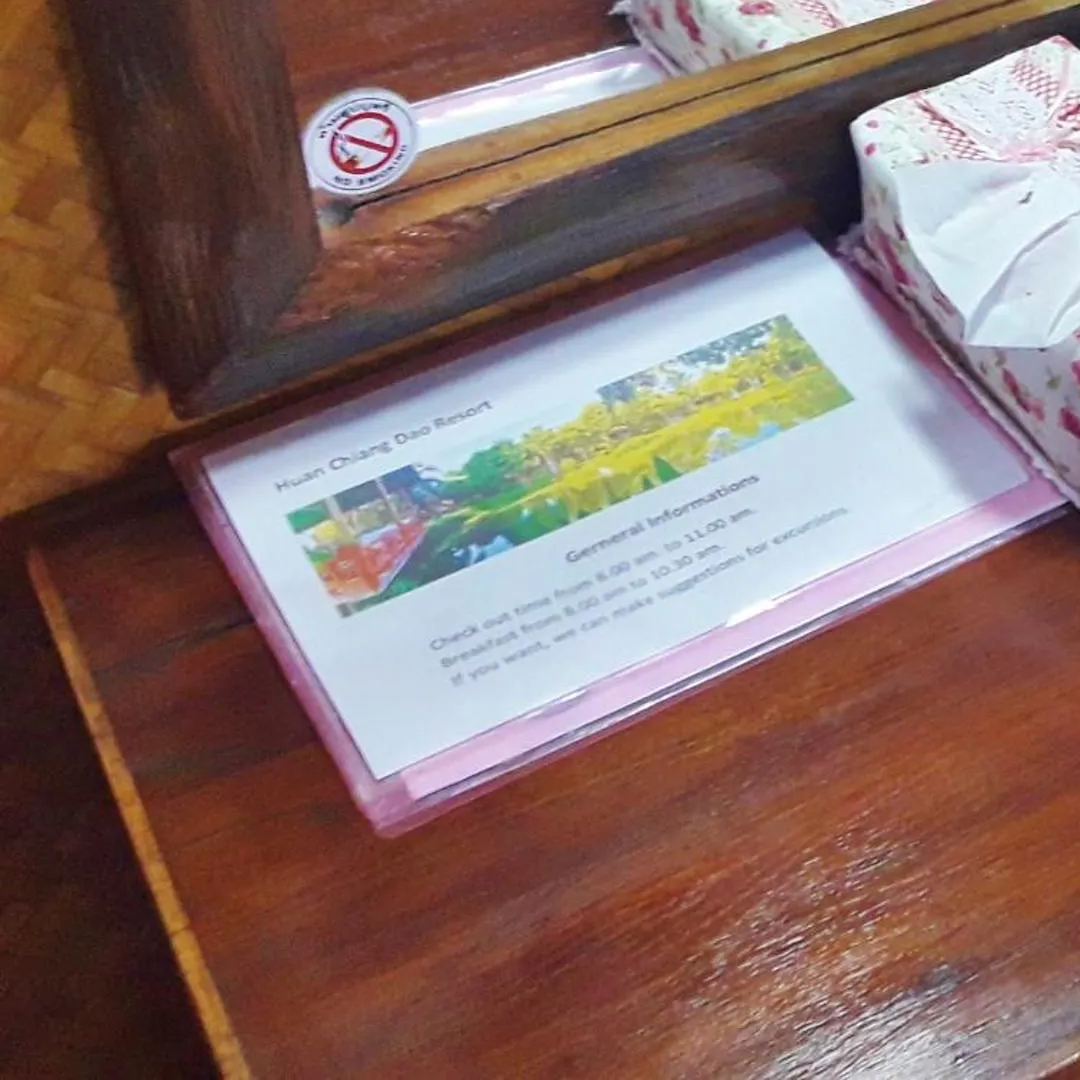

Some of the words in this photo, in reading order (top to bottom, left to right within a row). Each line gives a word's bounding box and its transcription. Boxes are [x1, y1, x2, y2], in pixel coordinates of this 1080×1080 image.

[328, 440, 393, 471] Chiang
[393, 424, 433, 445] Dao
[433, 400, 493, 430] Resort
[646, 474, 760, 528] Informations
[429, 625, 478, 650] Check
[513, 596, 551, 615] time
[663, 540, 682, 552] to
[684, 518, 727, 543] 11.00
[468, 662, 499, 681] you
[579, 615, 609, 632] can
[612, 596, 655, 619] make
[656, 553, 746, 600] suggestions
[745, 540, 769, 557] for
[629, 576, 648, 589] to
